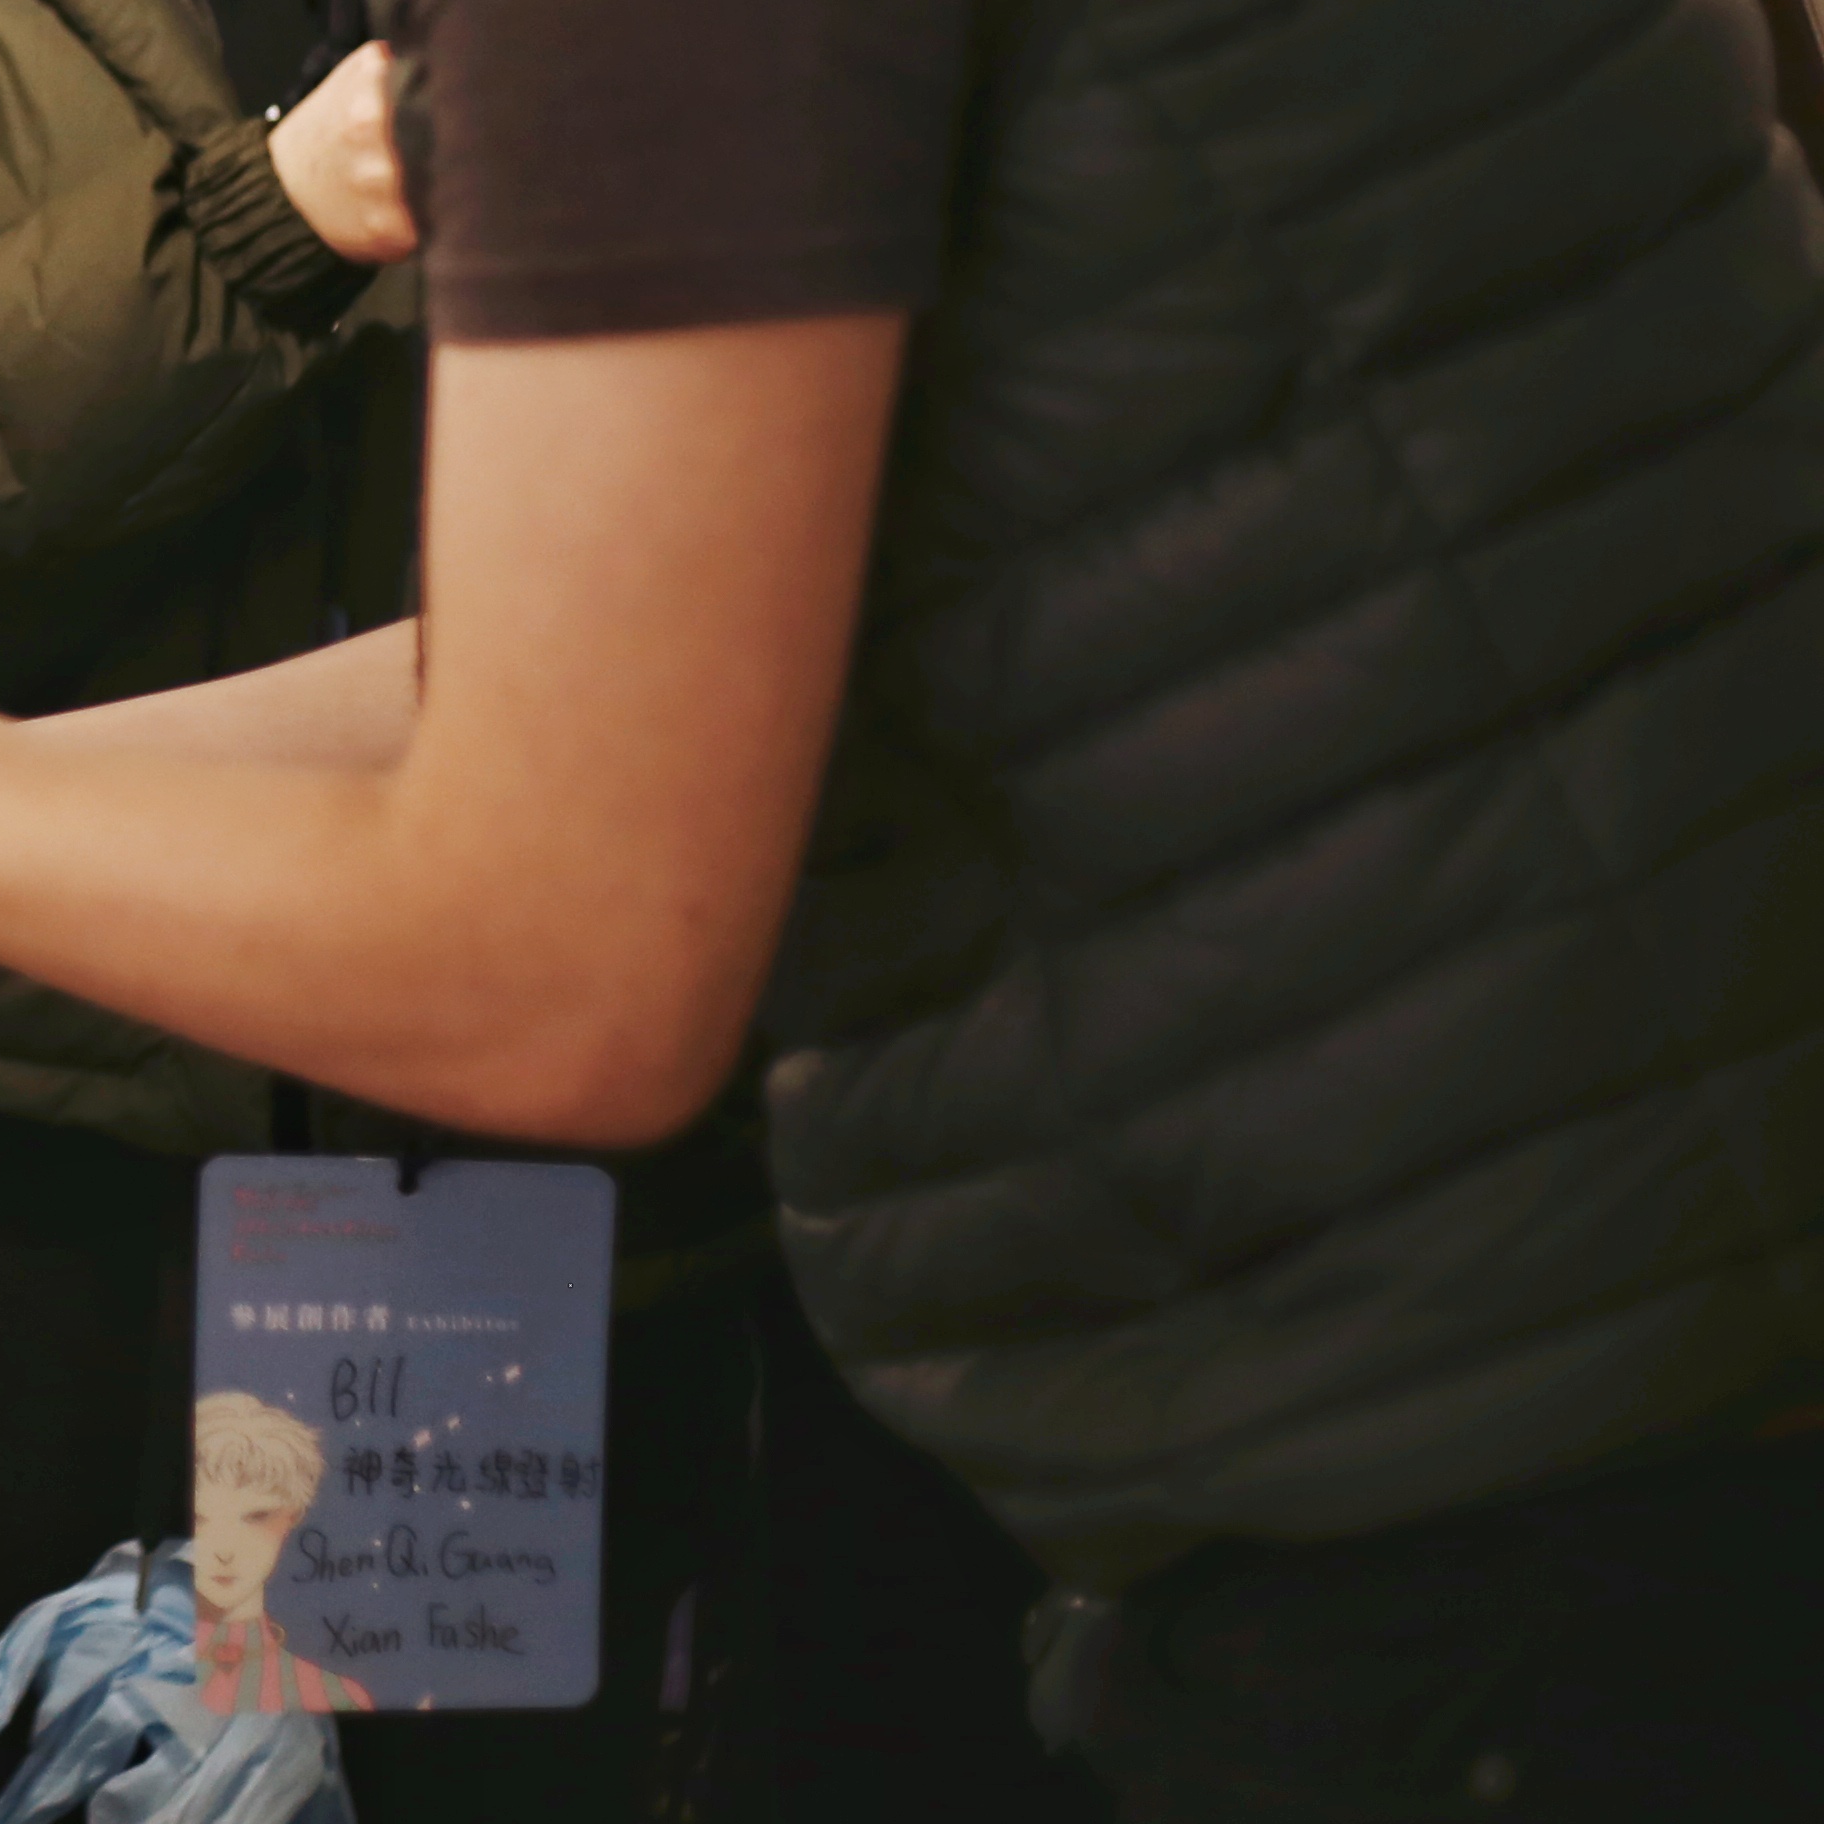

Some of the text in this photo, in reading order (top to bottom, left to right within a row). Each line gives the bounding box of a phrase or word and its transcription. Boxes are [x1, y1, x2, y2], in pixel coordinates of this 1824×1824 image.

[292, 1529, 374, 1582] Shen
[440, 1530, 556, 1585] Guang
[323, 1614, 401, 1657] Xian
